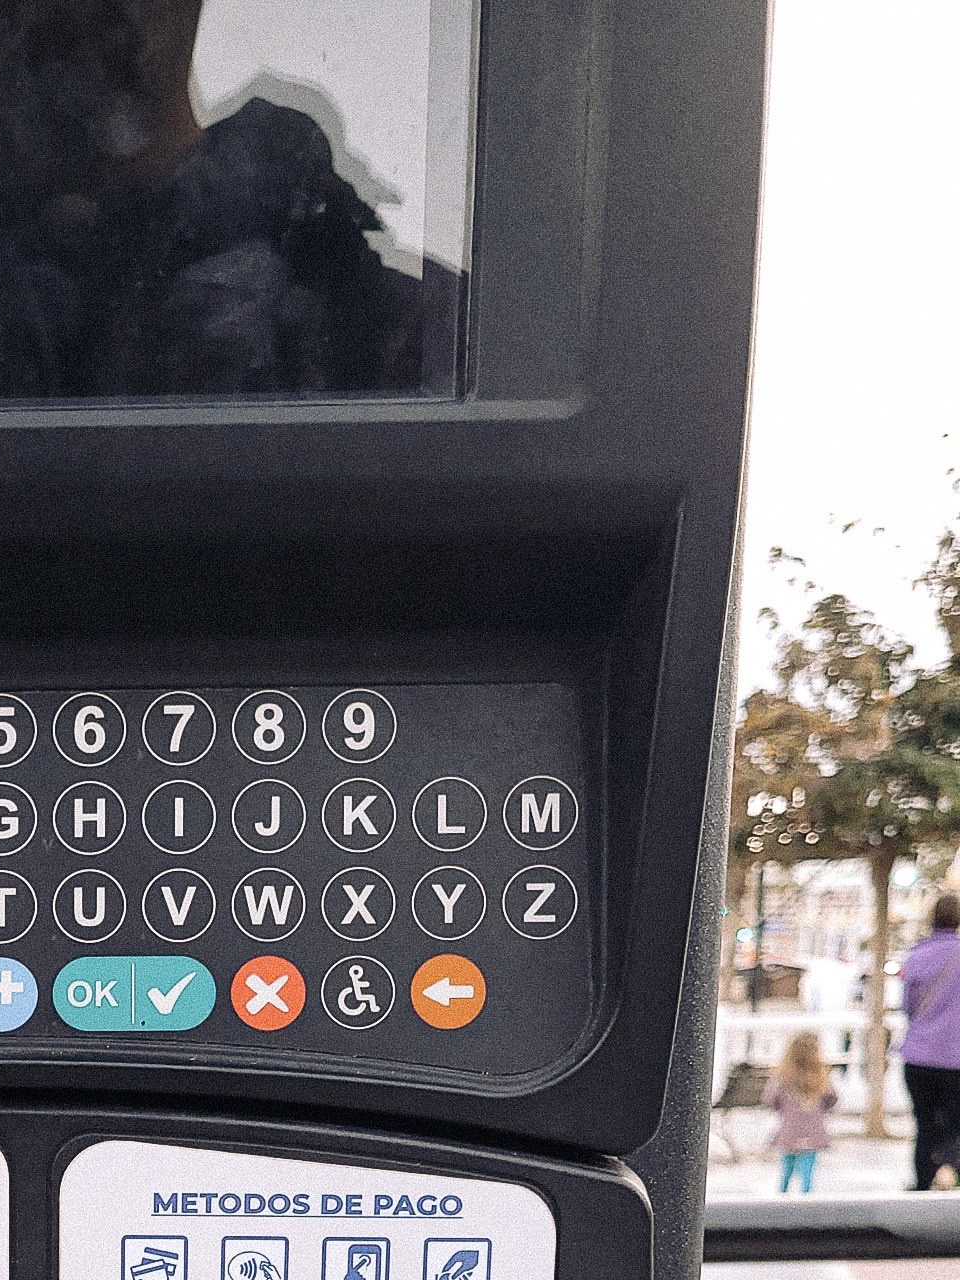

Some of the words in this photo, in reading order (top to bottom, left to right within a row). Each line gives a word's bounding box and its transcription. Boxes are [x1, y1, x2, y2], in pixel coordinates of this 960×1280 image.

[74, 706, 105, 753] 6
[164, 705, 194, 752] 7
[254, 704, 284, 751] 8
[344, 702, 374, 750] 9
[74, 798, 105, 837] H
[175, 798, 183, 836] I
[255, 796, 280, 836] J
[344, 796, 378, 835] K
[438, 795, 465, 833] L
[522, 793, 560, 832] M
[74, 887, 105, 926] U
[162, 887, 196, 925] V
[244, 886, 294, 924] W
[341, 885, 375, 924] X
[432, 884, 466, 923] Y
[524, 883, 555, 922] Z
[68, 981, 117, 1008] OK
[152, 1193, 310, 1216] METODOS
[321, 1194, 362, 1217] DE
[374, 1195, 462, 1217] PAGO
